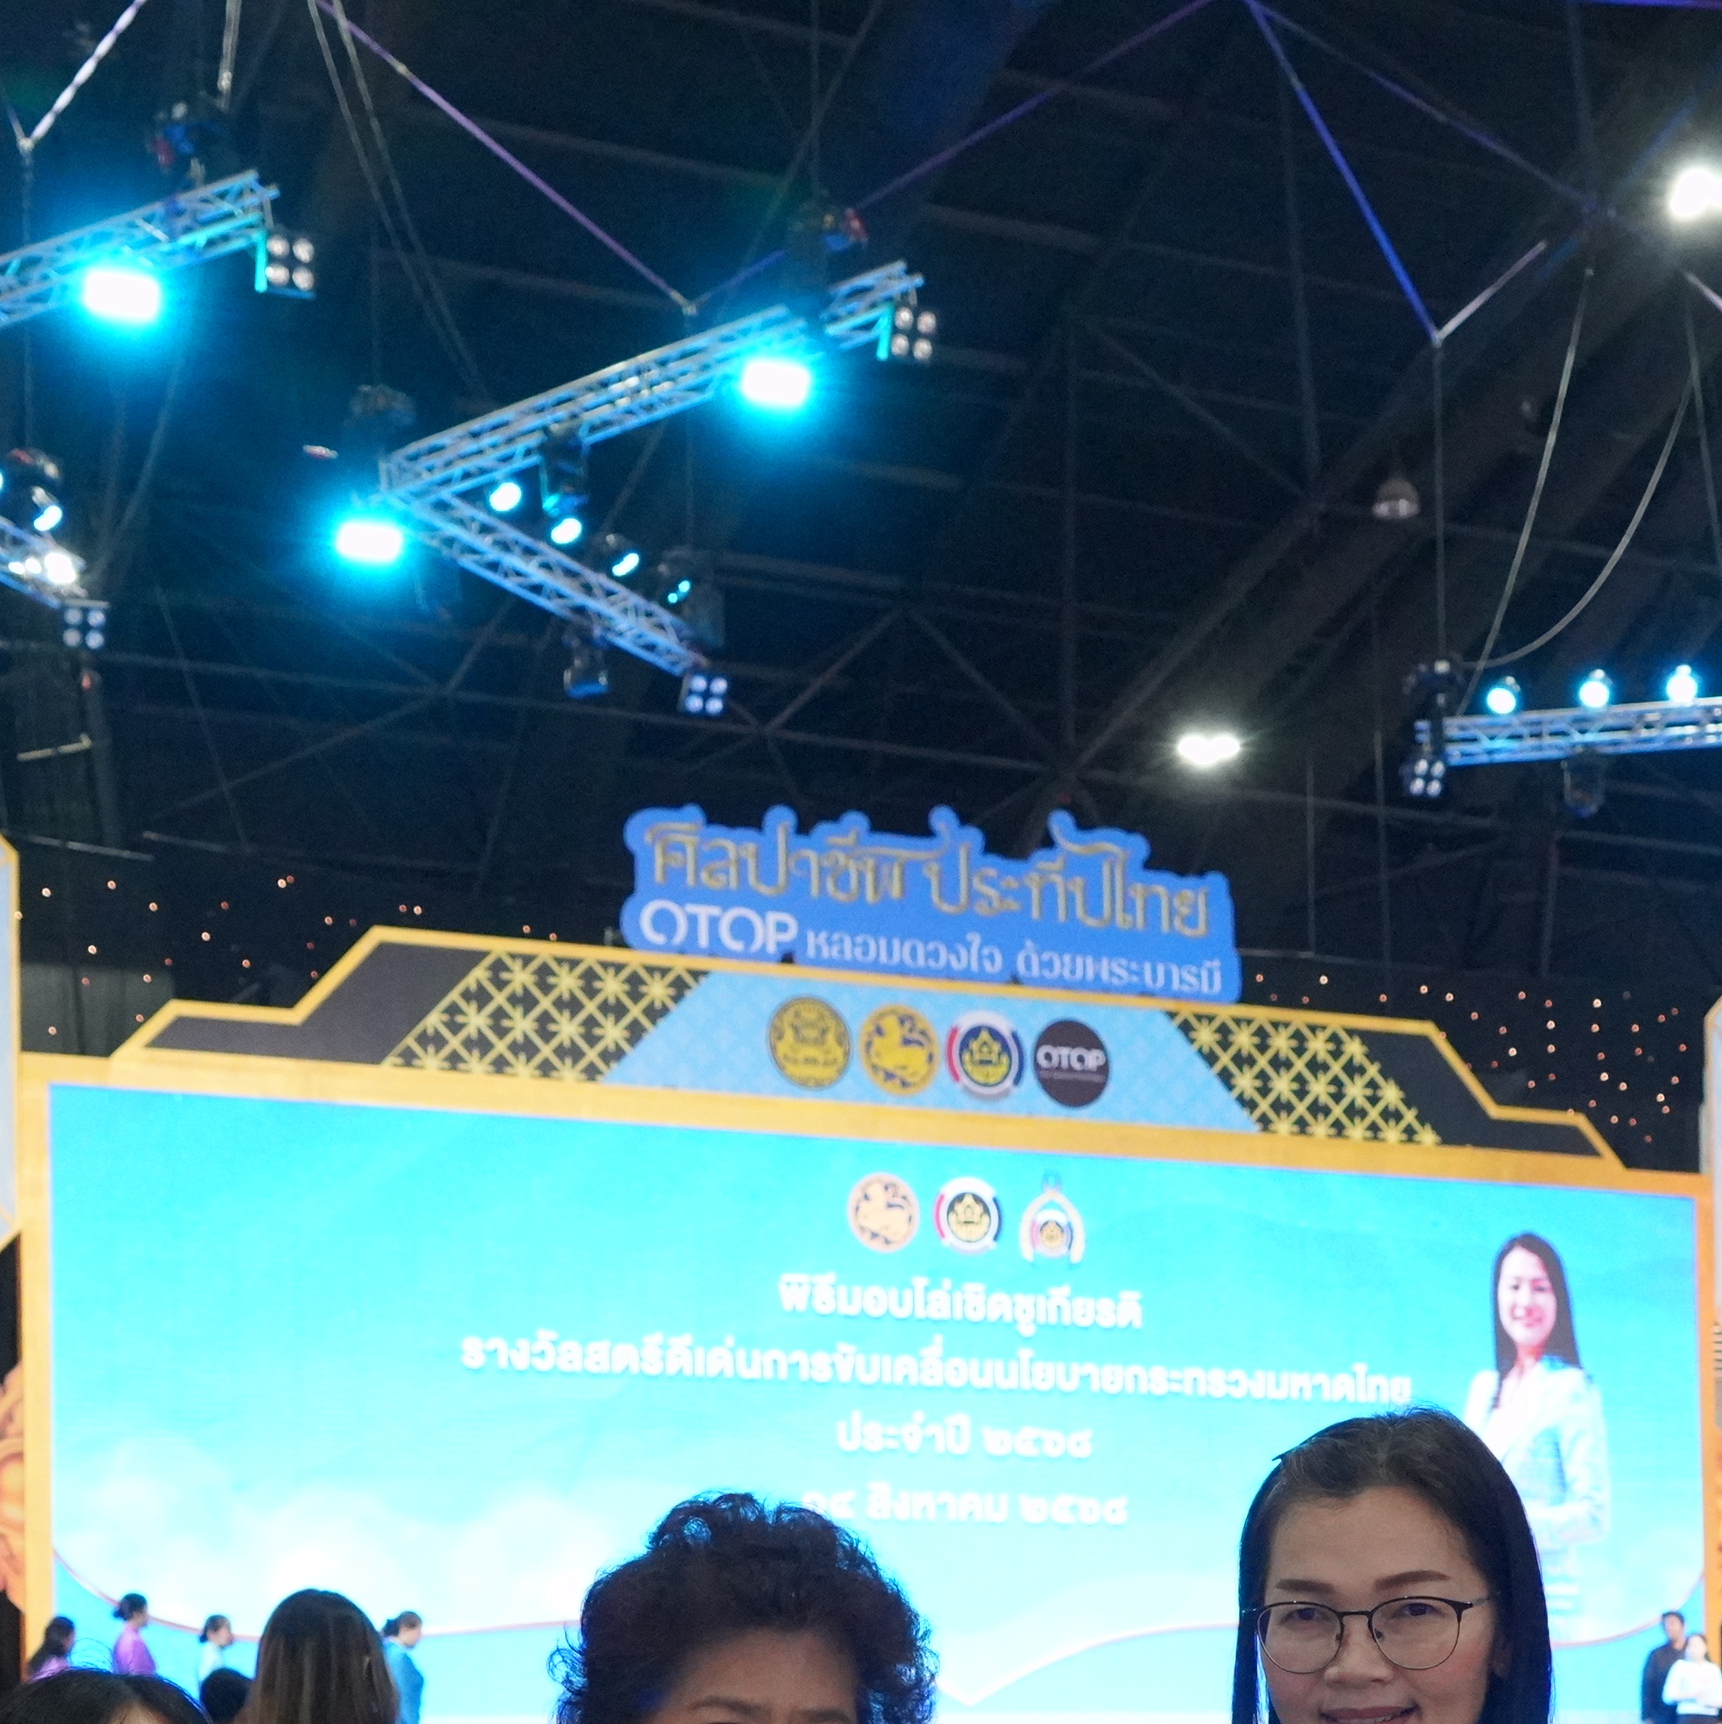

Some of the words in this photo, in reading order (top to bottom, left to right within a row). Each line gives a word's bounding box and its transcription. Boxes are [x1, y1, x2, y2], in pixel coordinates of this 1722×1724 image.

[639, 899, 799, 955] OTOP
[806, 931, 1004, 976] หลอมดวงใจ
[1036, 1044, 1107, 1072] OTOP
[777, 1271, 1143, 1337] พิธีมอบโล่เชิดชูเกียรติ
[835, 1409, 972, 1455] ประจำปี
[981, 1426, 1093, 1458] ๒๕๖๘
[865, 1481, 1009, 1523] สิงหาคม
[1018, 1493, 1128, 1524] ๒๕๖๘
